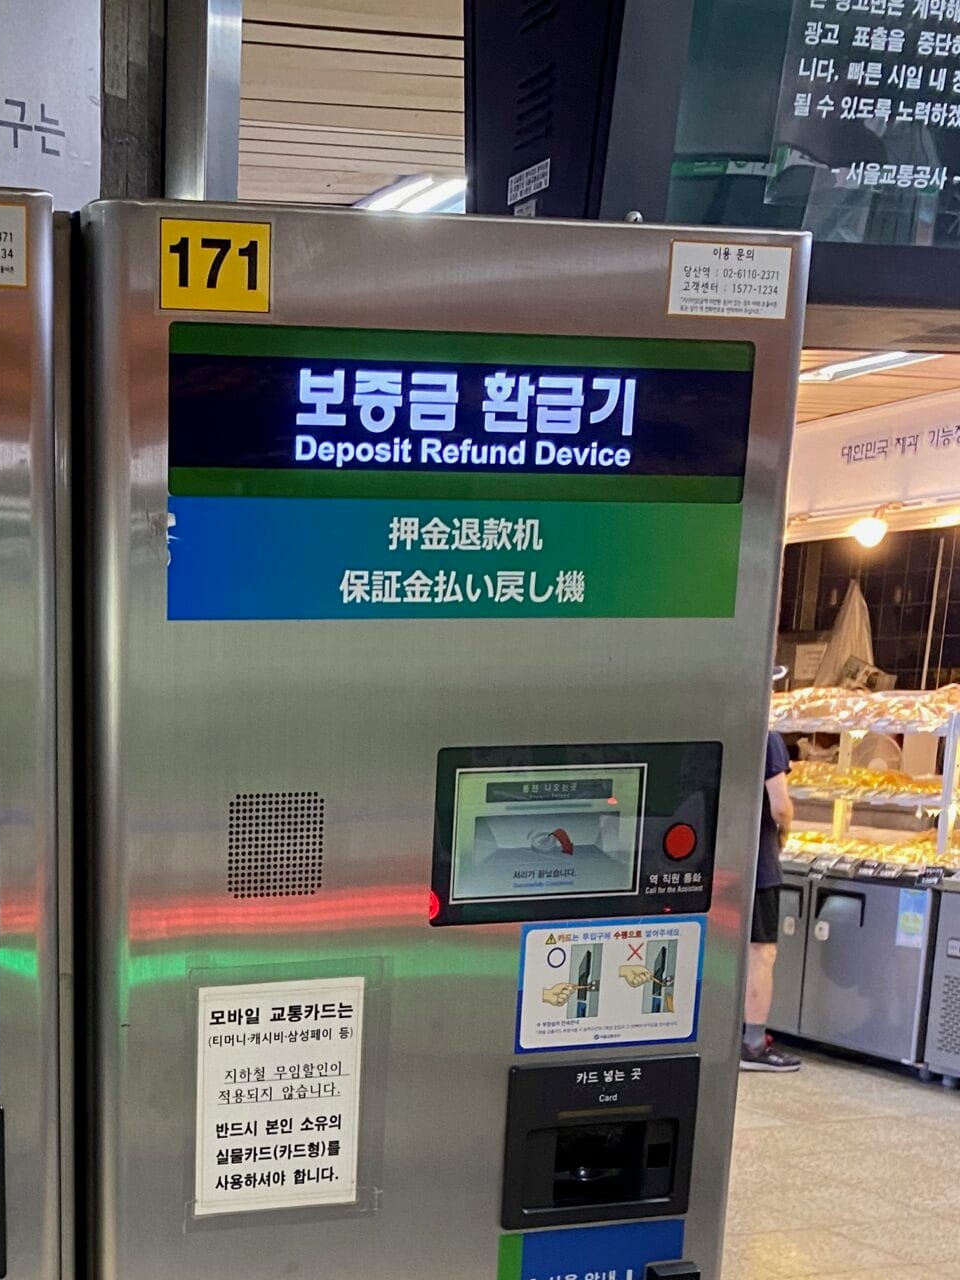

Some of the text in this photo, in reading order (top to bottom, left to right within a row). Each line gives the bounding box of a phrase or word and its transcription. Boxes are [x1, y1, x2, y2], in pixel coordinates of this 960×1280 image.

[805, 22, 839, 45] 광고
[852, 26, 905, 52] 표출을
[799, 57, 839, 83] 니다.
[847, 61, 882, 85] 빠른
[888, 64, 923, 89] 시일
[929, 68, 947, 91] 내
[794, 93, 811, 116] 될
[817, 94, 834, 118] 수
[840, 96, 891, 121] 있도록
[846, 161, 947, 189] 서울교통공사
[168, 237, 259, 291] 171
[713, 247, 754, 261] 이용 문의
[684, 265, 779, 280] 당산역 02-6110-2371
[682, 282, 778, 295] 고객센터 1577-1234
[296, 368, 635, 437] 보증금 환급기
[294, 436, 631, 468] Deposit Refund Device
[841, 439, 889, 464] 대한민국
[388, 517, 543, 552] 押金退款机
[339, 570, 585, 605] 保証金払い戻し機
[209, 1002, 354, 1026] 모바일 교통카드는
[338, 1027, 354, 1040] 등)
[224, 1061, 342, 1084] 지하철 무임할인이
[576, 1068, 642, 1084] 카드 넣는 곳
[218, 1081, 341, 1105] 적용되지 않습니다.
[599, 1093, 618, 1103] Card
[215, 1114, 342, 1139] 반드시 본인 소유의
[216, 1140, 340, 1165] 실물카드(카드형)를
[216, 1166, 339, 1191] 사용하셔야 합니다.
